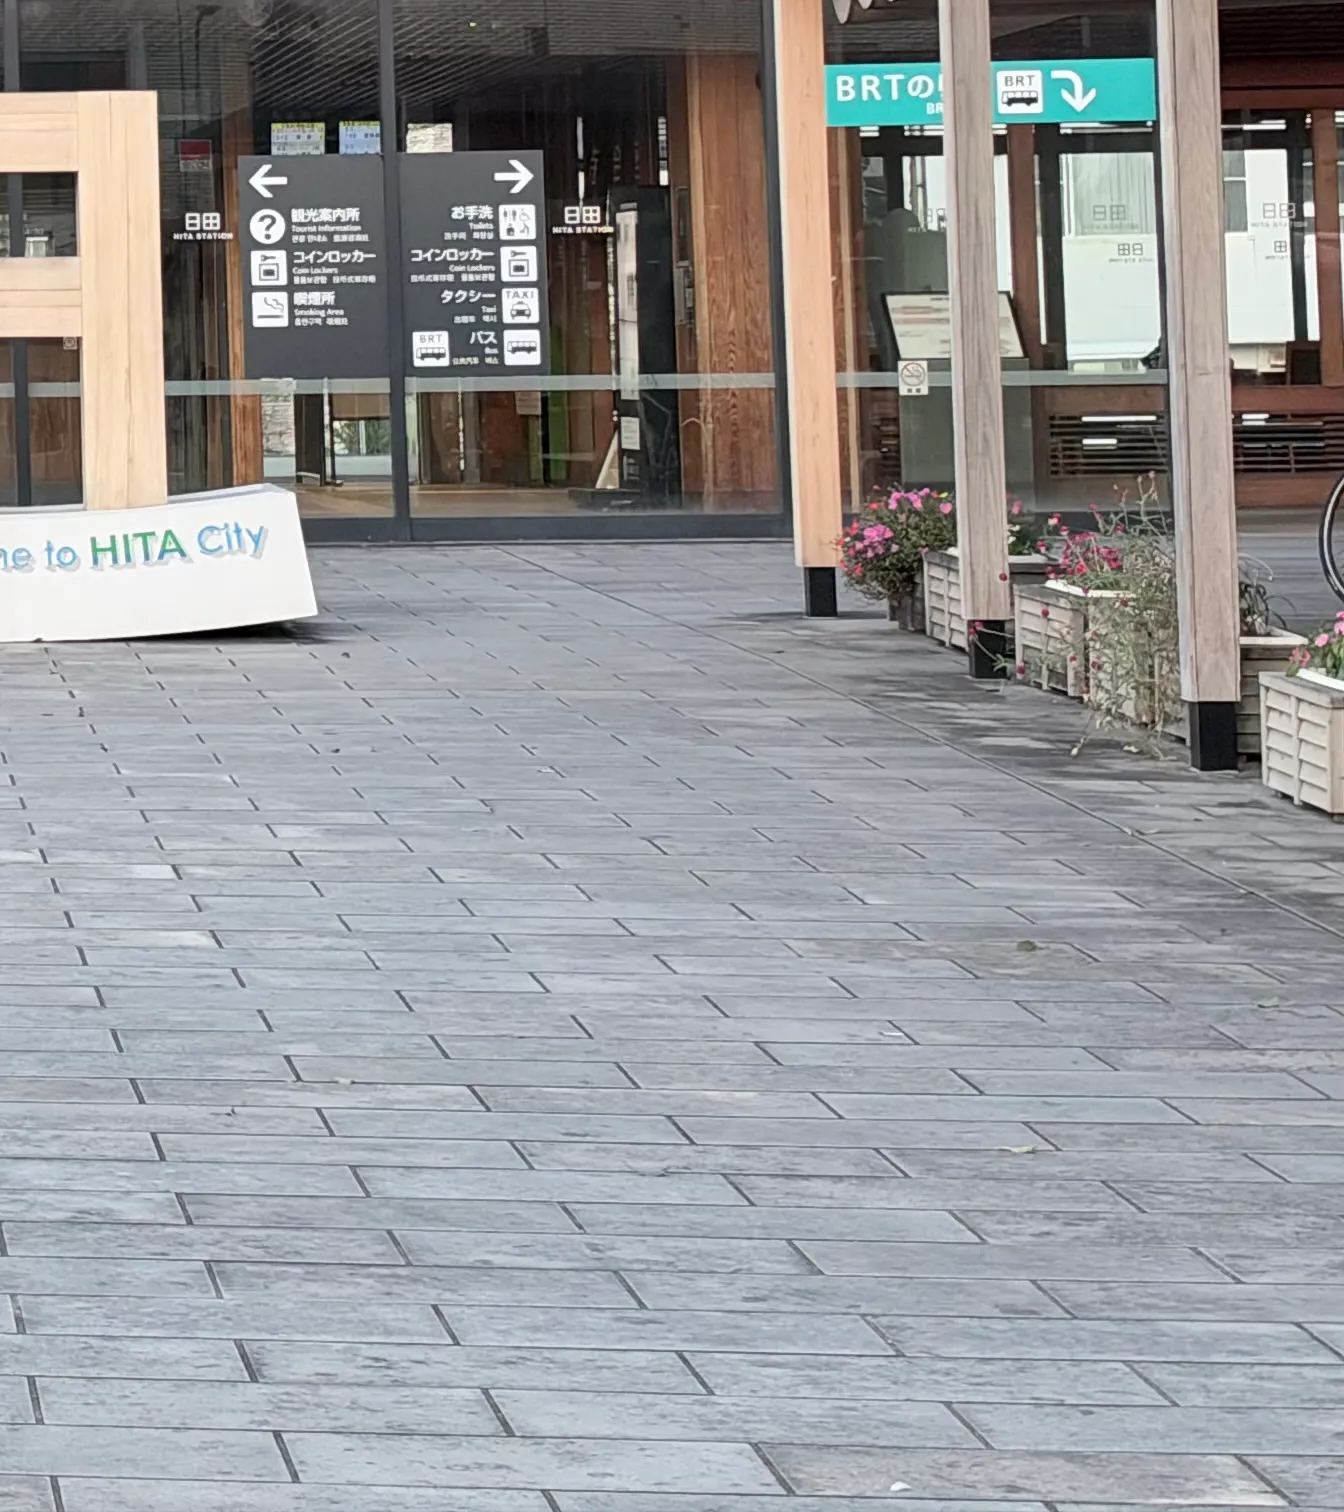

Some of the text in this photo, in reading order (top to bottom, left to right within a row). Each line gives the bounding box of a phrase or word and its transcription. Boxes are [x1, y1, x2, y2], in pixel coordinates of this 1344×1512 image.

[836, 74, 944, 102] BRTの
[1004, 75, 1036, 87] BRT
[926, 102, 944, 115] BR
[185, 212, 221, 231] 日田
[291, 207, 360, 223] 観光案内所
[565, 206, 601, 224] 日田
[173, 232, 234, 241] HITA STATION
[551, 226, 574, 235] HITA
[293, 249, 377, 264] コインロッカー
[410, 248, 496, 262] コインロッカー
[440, 289, 497, 304] タクシー
[505, 290, 535, 299] TAXI
[419, 334, 443, 343] BRT
[469, 330, 498, 345] バス
[46, 539, 77, 568] to
[90, 528, 188, 567] HITA
[197, 521, 265, 559] City
